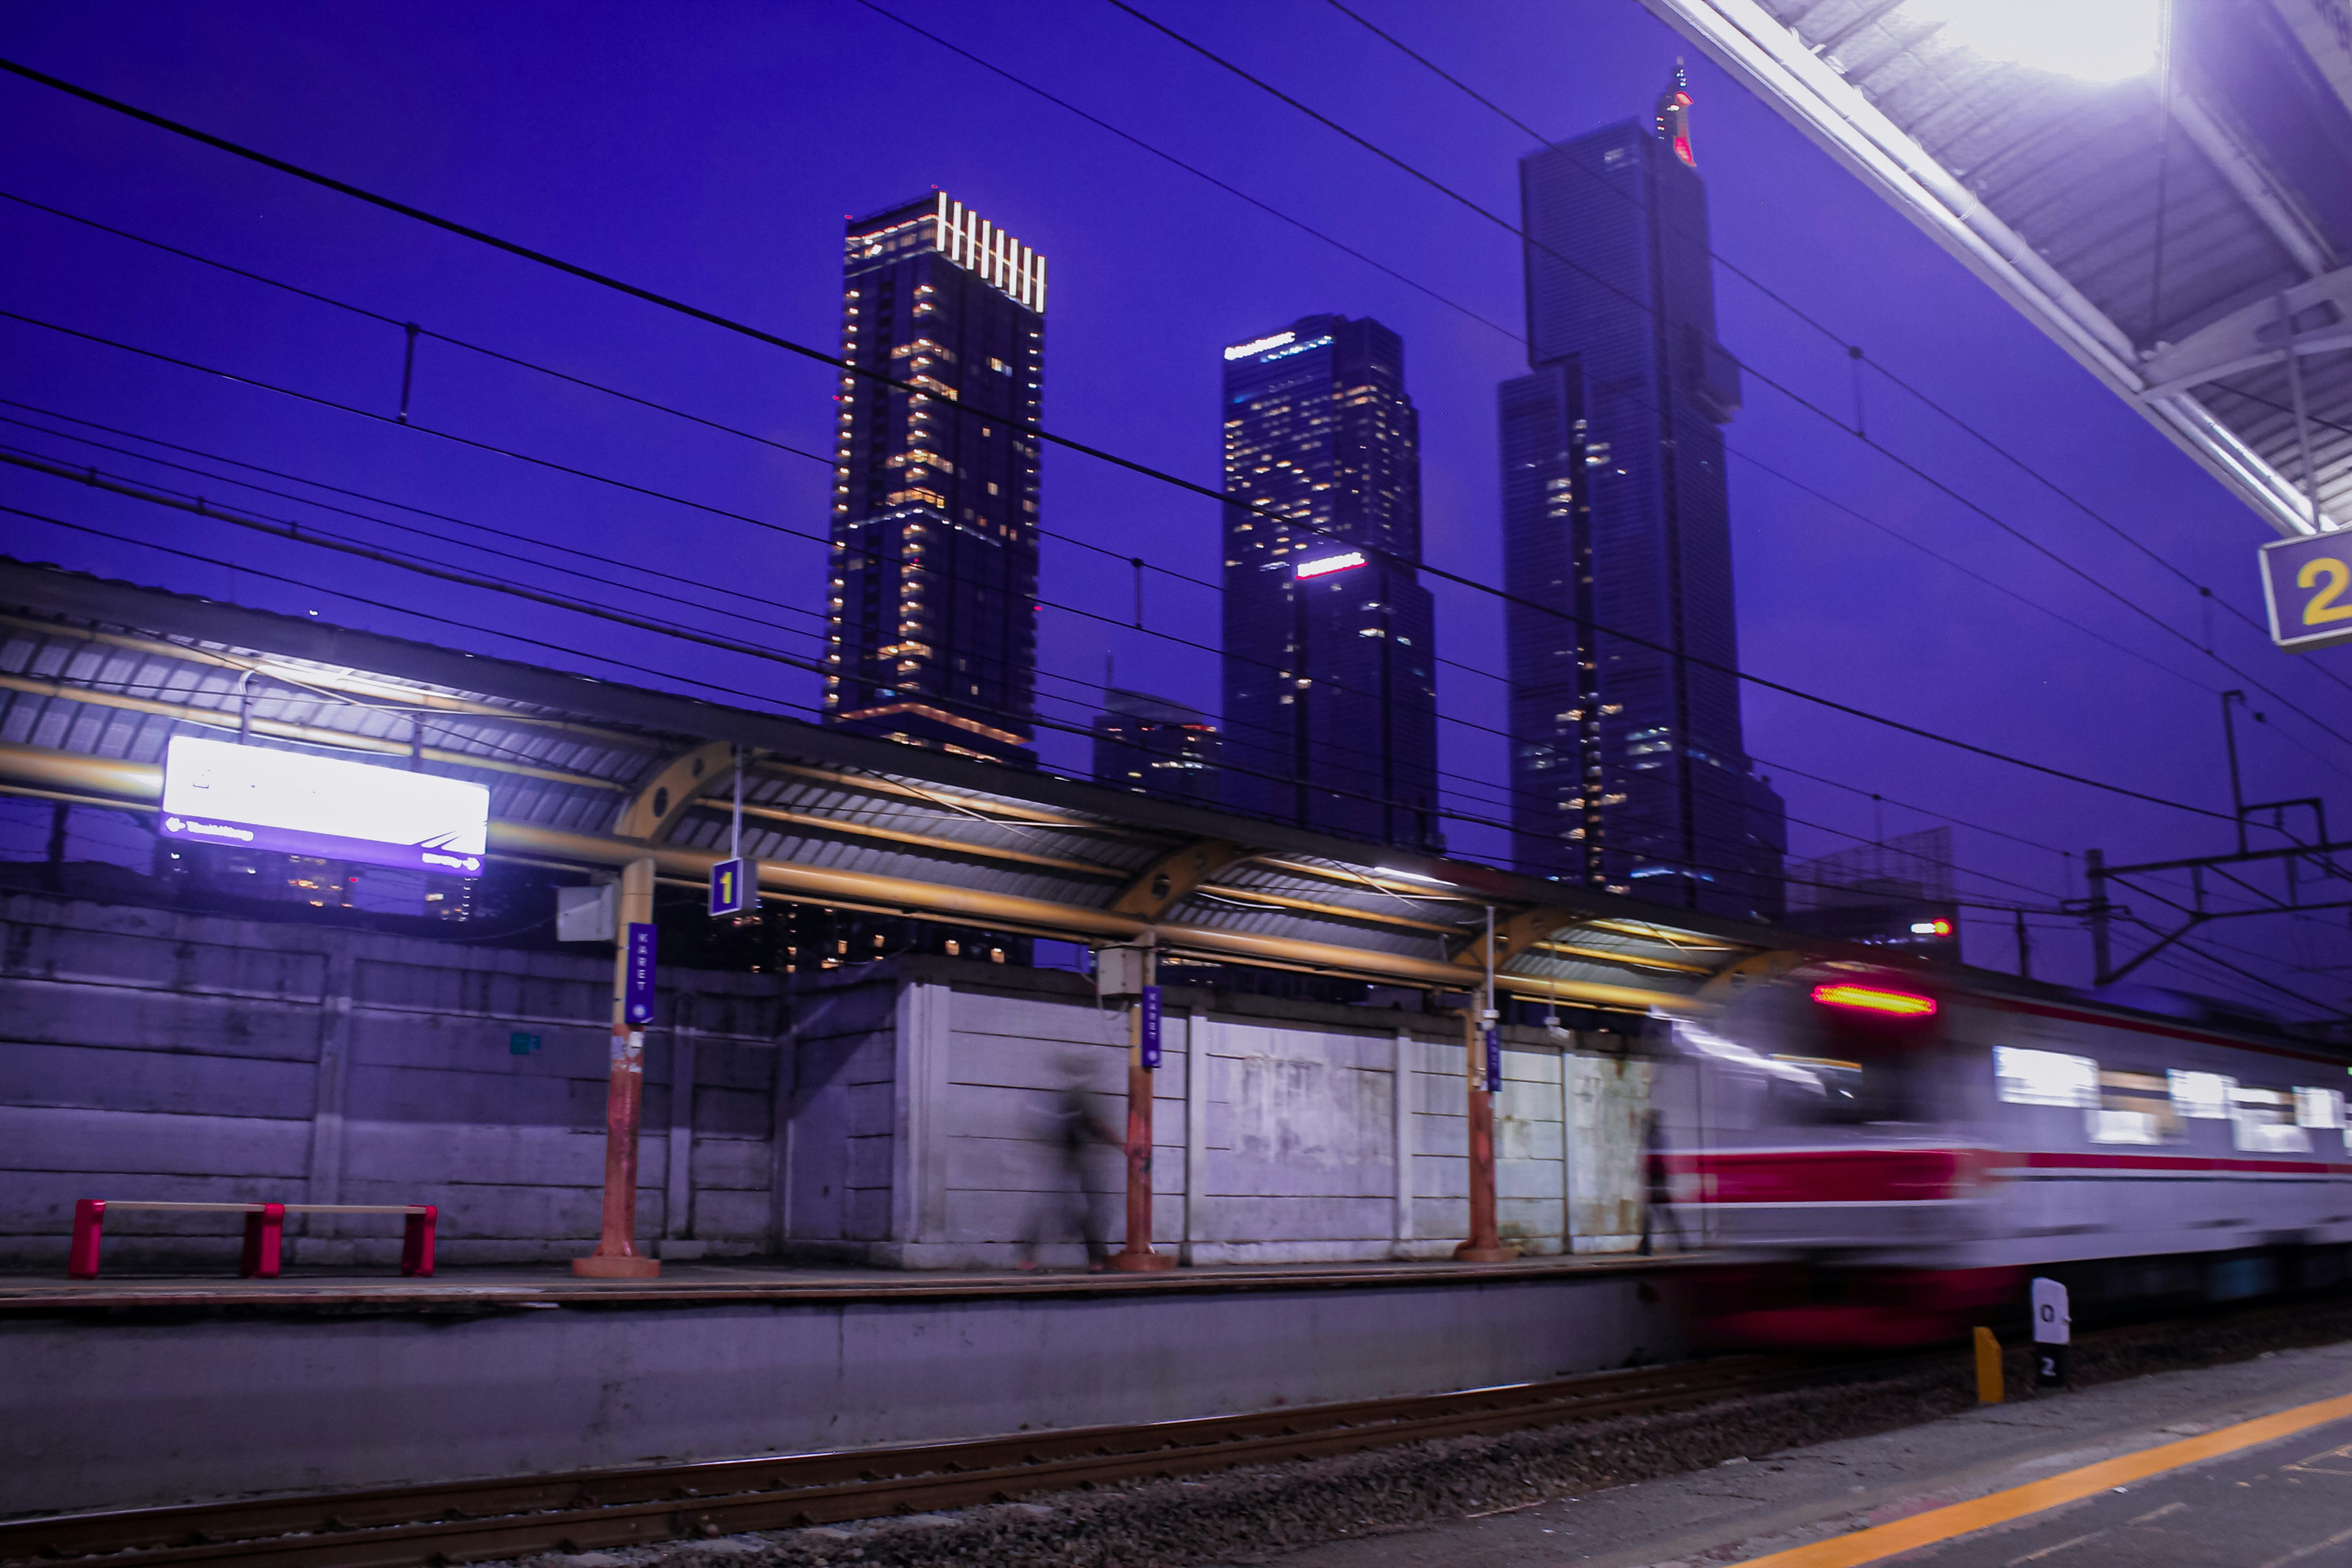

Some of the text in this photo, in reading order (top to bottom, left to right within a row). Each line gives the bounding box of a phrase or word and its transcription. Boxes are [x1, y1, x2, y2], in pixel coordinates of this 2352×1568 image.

[2296, 557, 2352, 626] 2
[720, 872, 733, 904] 1
[636, 933, 649, 991] KARET
[2040, 1357, 2056, 1377] 2
